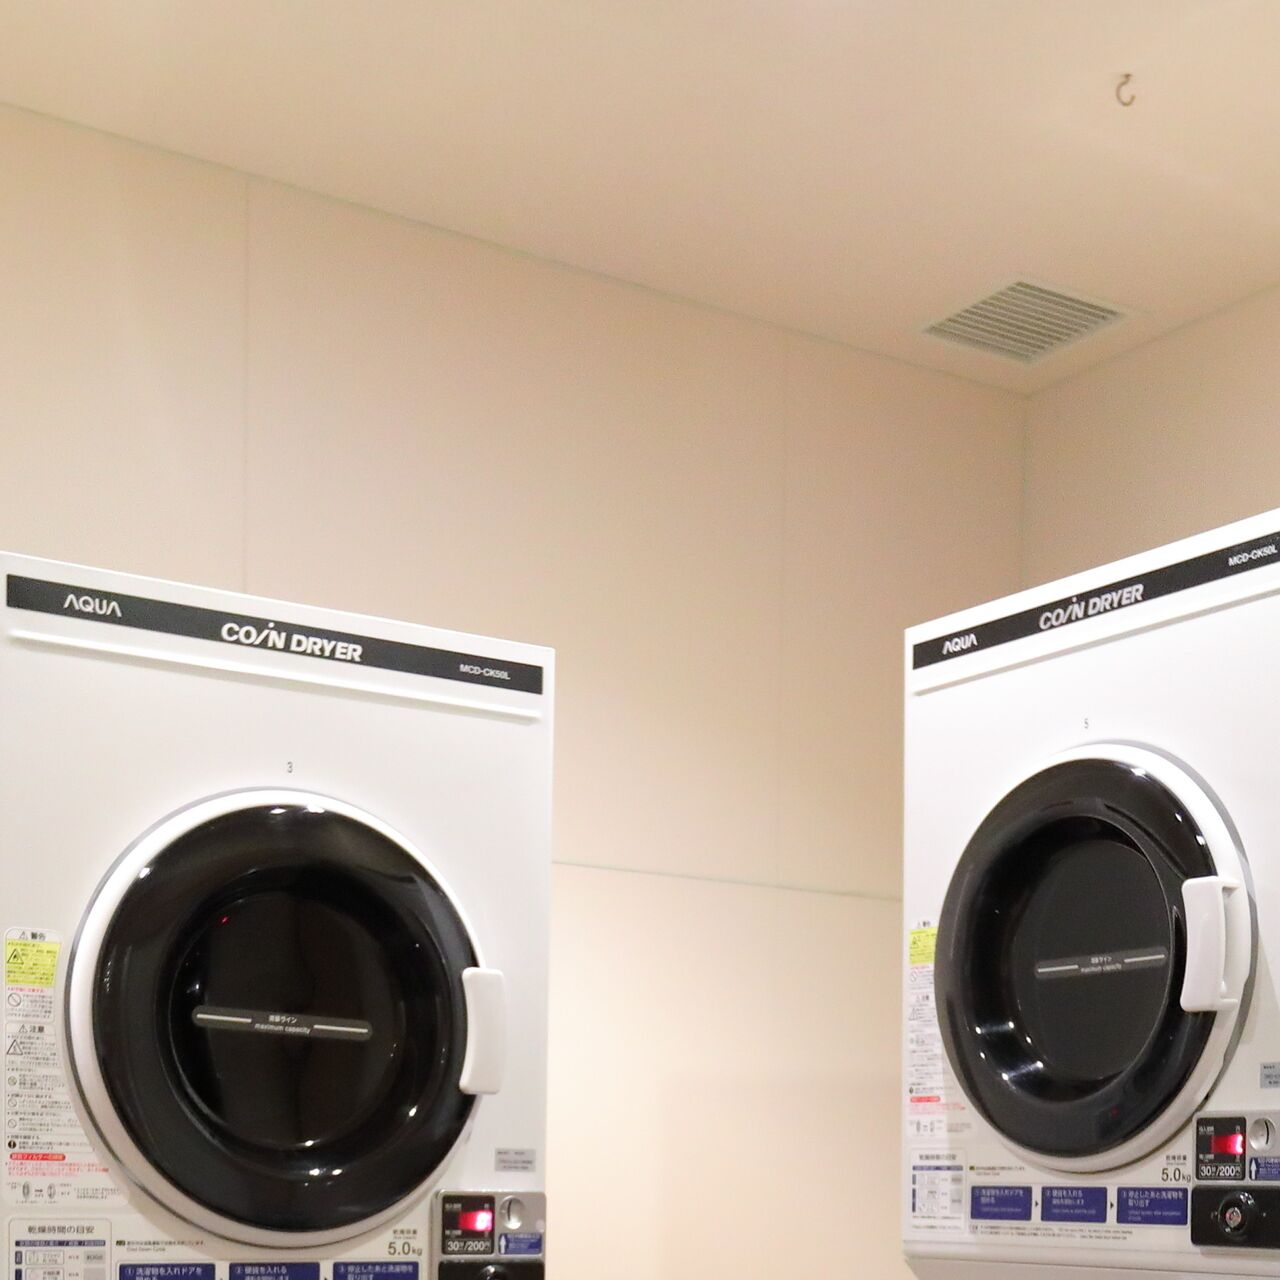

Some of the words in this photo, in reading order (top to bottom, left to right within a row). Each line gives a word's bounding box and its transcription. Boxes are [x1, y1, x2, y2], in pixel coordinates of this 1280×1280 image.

[1228, 543, 1279, 567] MCD-CK50L
[63, 593, 122, 618] AQUA
[1087, 583, 1144, 616] DRYER
[289, 635, 363, 663] DRYER
[942, 633, 978, 655] AQUA
[459, 662, 511, 681] MCD-CK50L
[286, 761, 294, 773] 3
[254, 1023, 284, 1032] maximum
[285, 1025, 311, 1034] capacity
